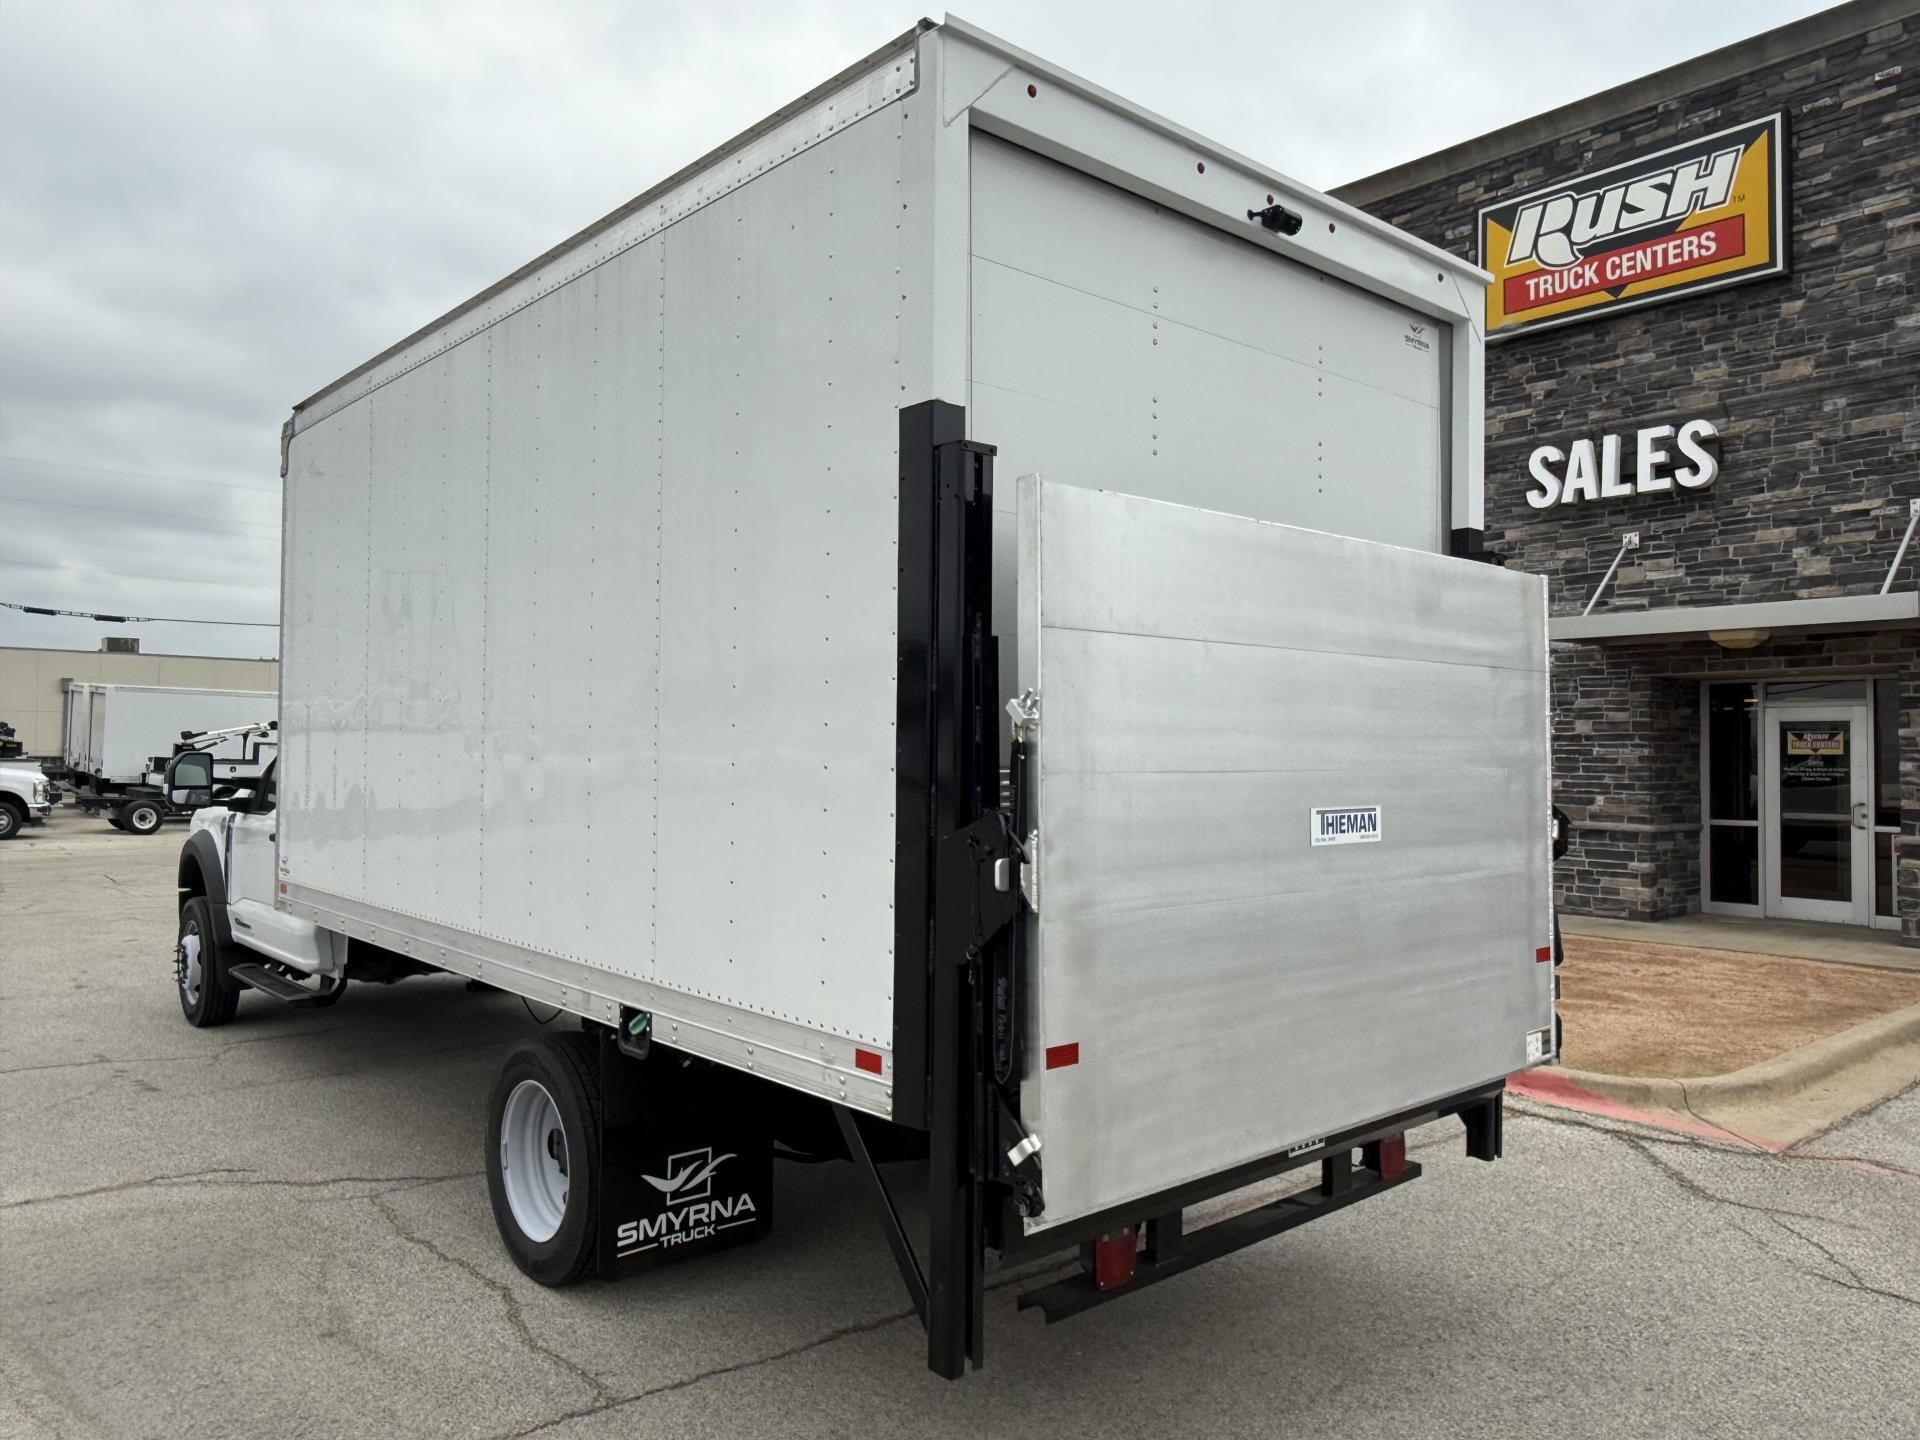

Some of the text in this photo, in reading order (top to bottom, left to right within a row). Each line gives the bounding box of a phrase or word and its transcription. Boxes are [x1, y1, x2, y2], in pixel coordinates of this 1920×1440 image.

[1525, 230, 1718, 301] TRUCK CENTERS
[1525, 418, 1720, 510] SALES
[1316, 807, 1377, 836] THIEMAN
[617, 1193, 756, 1248] SMYRNA
[660, 1223, 716, 1249] TRUCK
